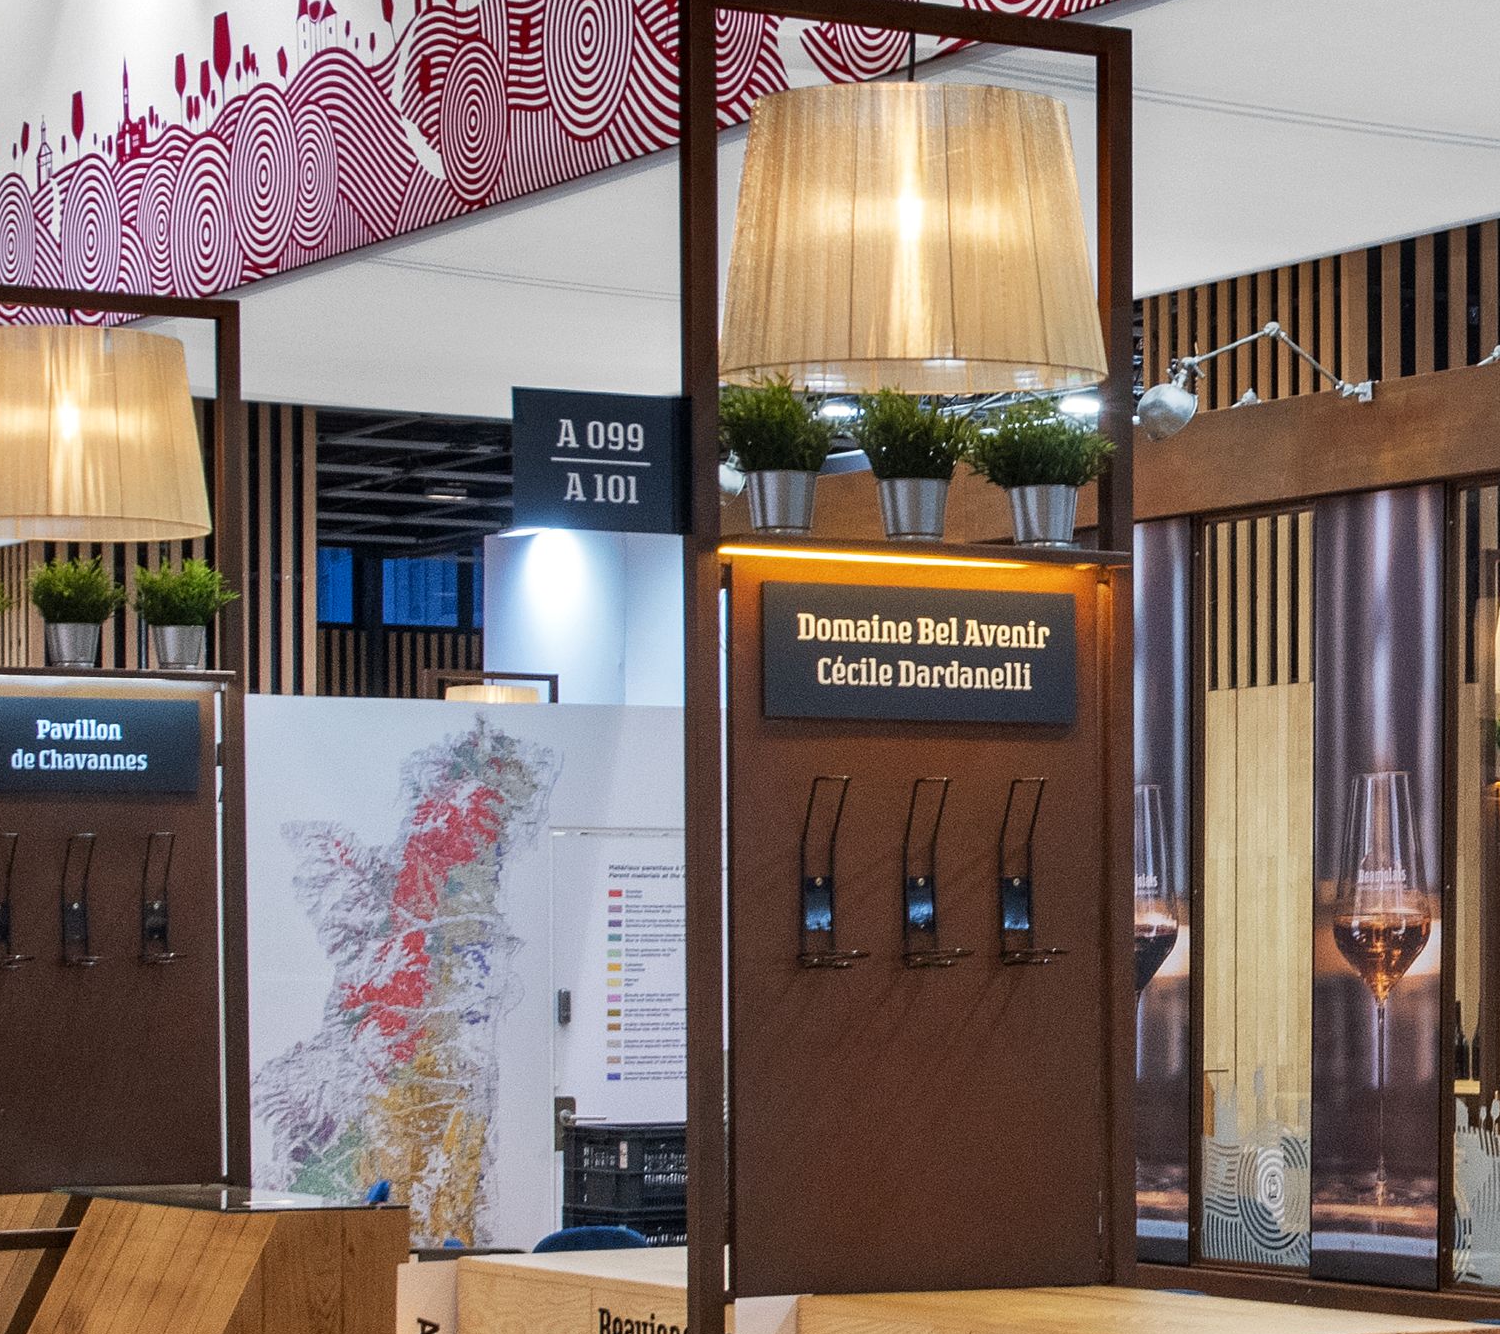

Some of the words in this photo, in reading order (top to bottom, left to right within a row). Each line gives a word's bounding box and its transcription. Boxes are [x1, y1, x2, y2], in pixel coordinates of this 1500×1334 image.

[556, 419, 579, 447] A
[587, 421, 644, 451] 099
[563, 472, 587, 501] A
[594, 473, 639, 504] 101
[797, 613, 912, 644] Domaine
[916, 617, 960, 646] Bel
[963, 619, 1050, 649] Avenir
[817, 655, 893, 687] Cécile
[898, 660, 1032, 691] Dardanelli
[36, 719, 122, 740] Pavillon
[11, 749, 35, 770] de
[39, 749, 148, 771] Chavannes
